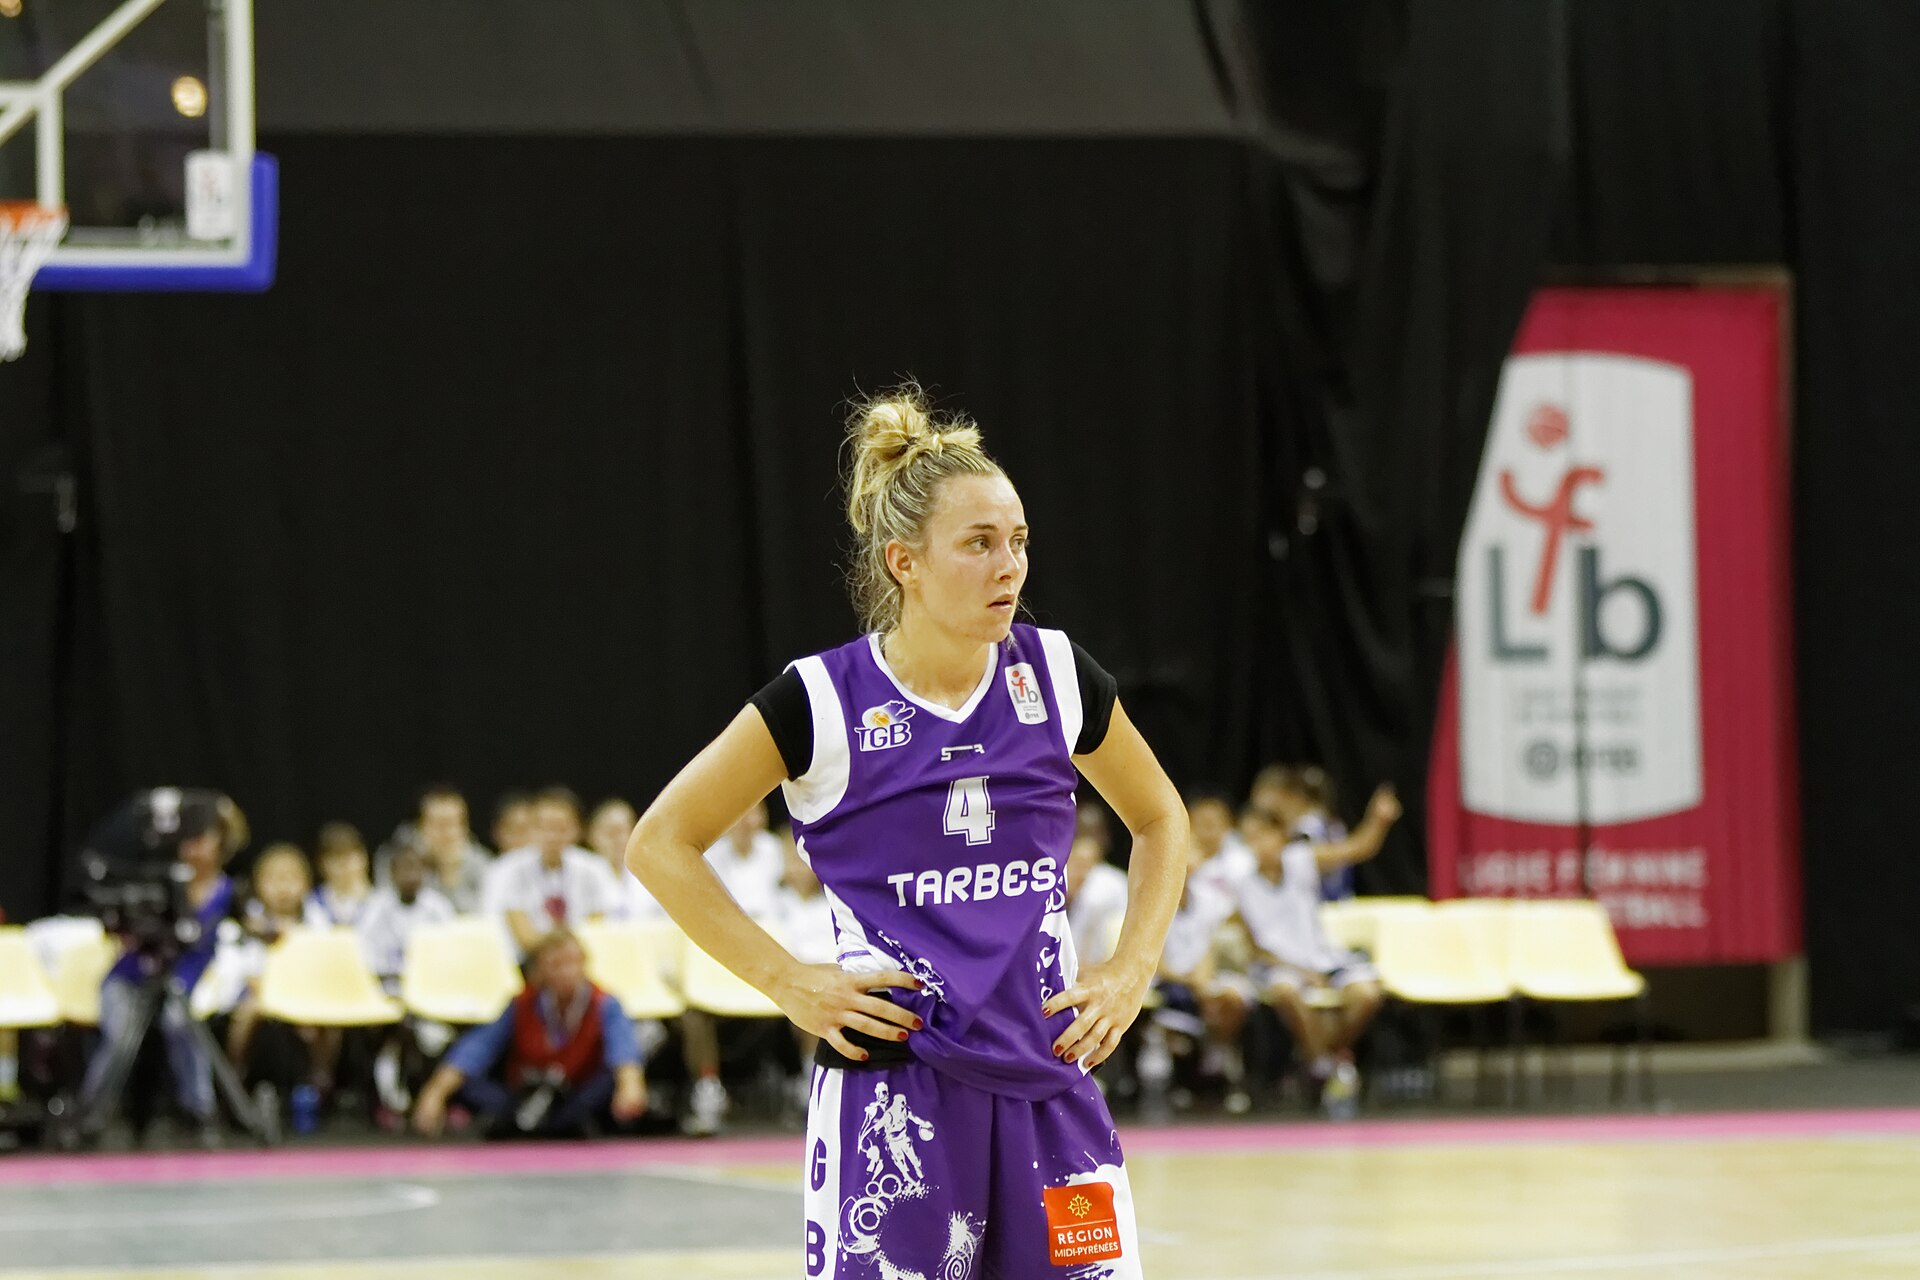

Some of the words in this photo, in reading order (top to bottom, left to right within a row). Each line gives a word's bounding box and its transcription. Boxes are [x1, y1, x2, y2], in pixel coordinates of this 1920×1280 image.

[855, 722, 911, 750] TGB
[943, 776, 995, 846] 4
[887, 857, 1057, 907] TARBES
[1054, 1241, 1119, 1258] MIDI-PYRÉNÉES
[1057, 1226, 1113, 1245] RÉGION
